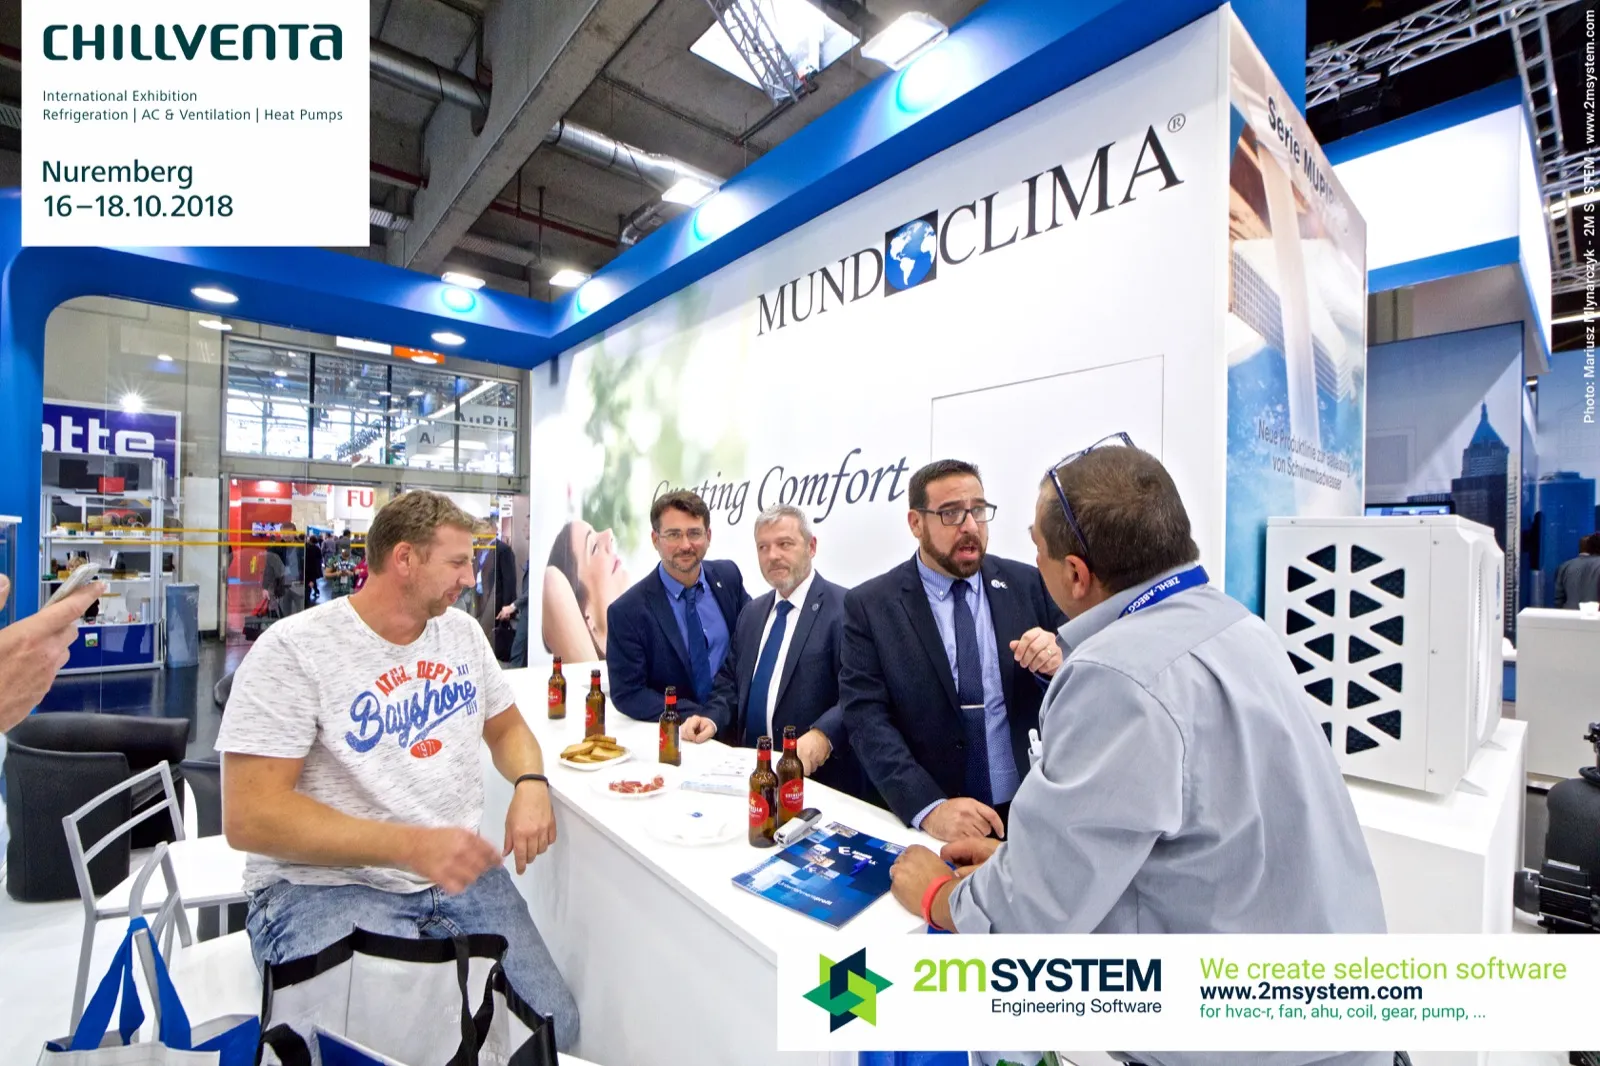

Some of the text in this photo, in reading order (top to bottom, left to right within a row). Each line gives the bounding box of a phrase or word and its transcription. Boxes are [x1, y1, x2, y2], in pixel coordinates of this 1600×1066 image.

[1267, 96, 1301, 164] Serie
[757, 447, 910, 524] Comfort
[1272, 455, 1286, 474] von
[417, 660, 453, 683] DEPT
[345, 679, 477, 753] Bayshore
